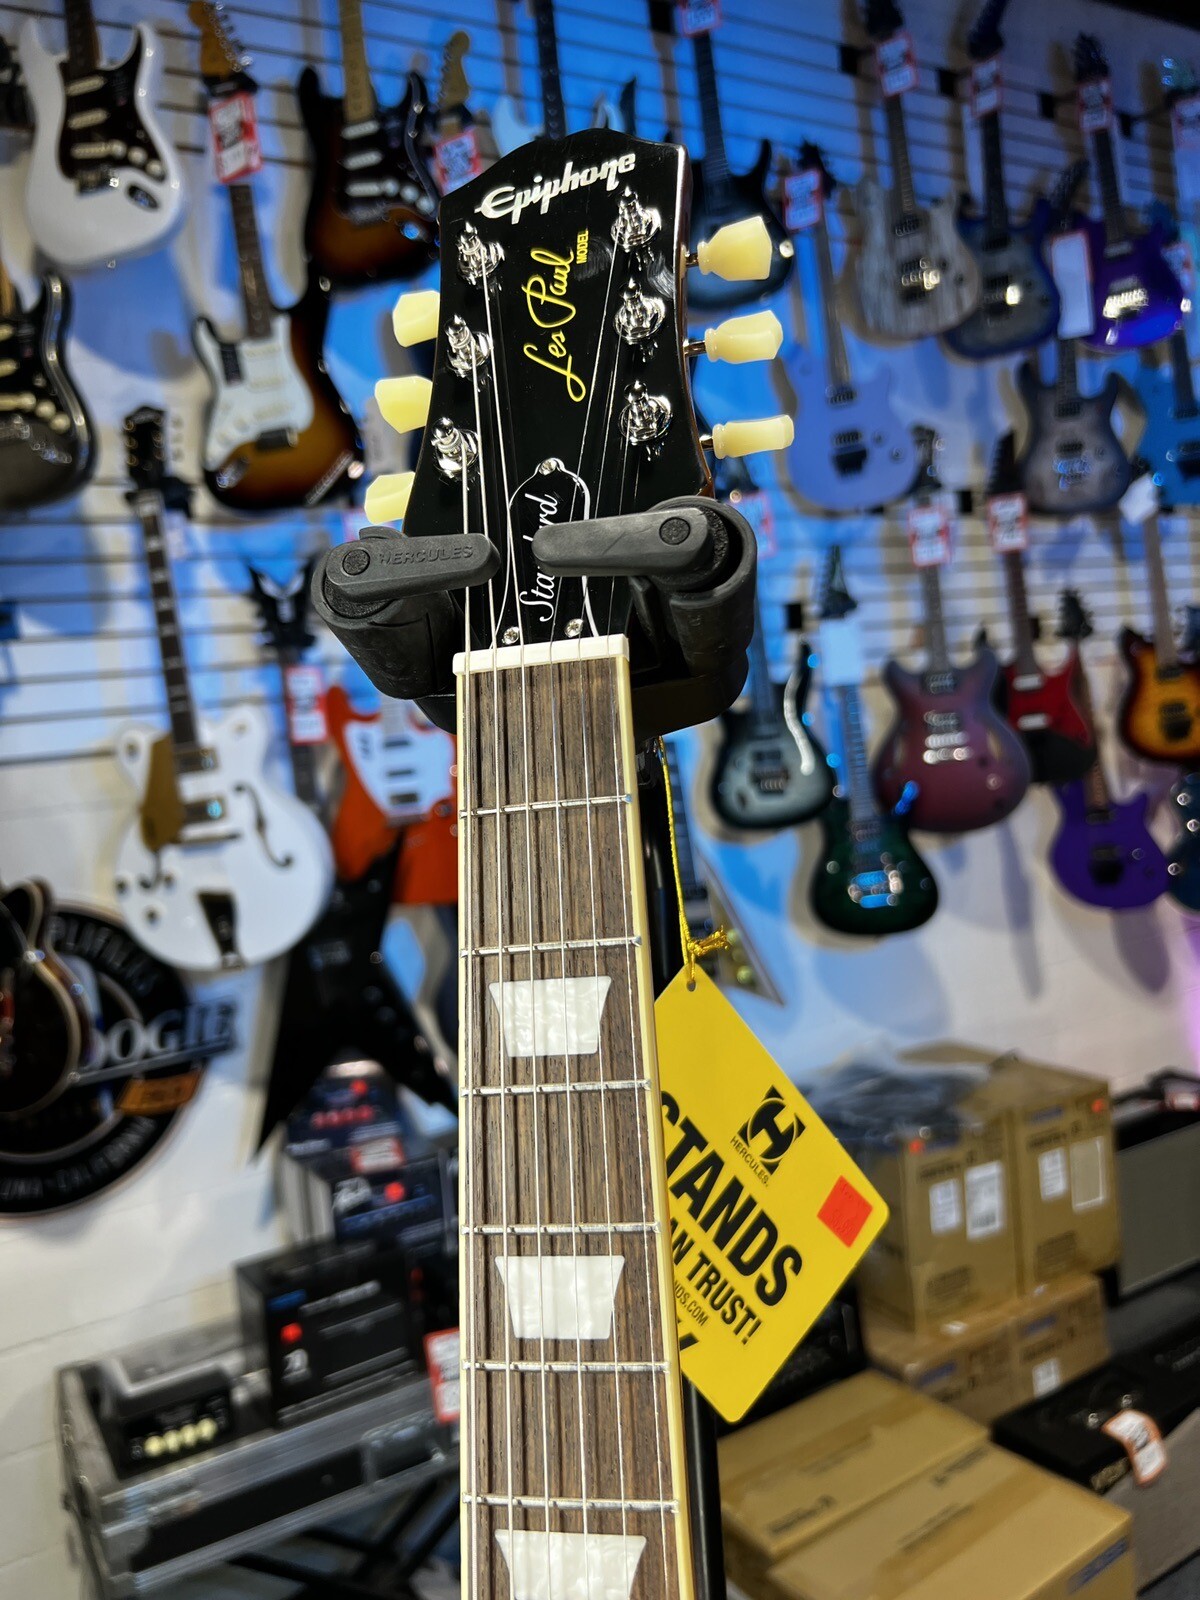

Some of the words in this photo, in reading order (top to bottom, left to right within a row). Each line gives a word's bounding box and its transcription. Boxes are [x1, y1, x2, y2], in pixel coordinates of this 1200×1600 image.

[474, 153, 636, 225] Epiphone
[576, 228, 590, 265] MODEL
[521, 247, 577, 329] Paul
[523, 329, 587, 403] Les
[379, 545, 474, 566] HERCULES
[518, 492, 559, 623] Stard
[730, 1135, 769, 1185] HERCULES
[686, 1249, 763, 1346] TRUST!
